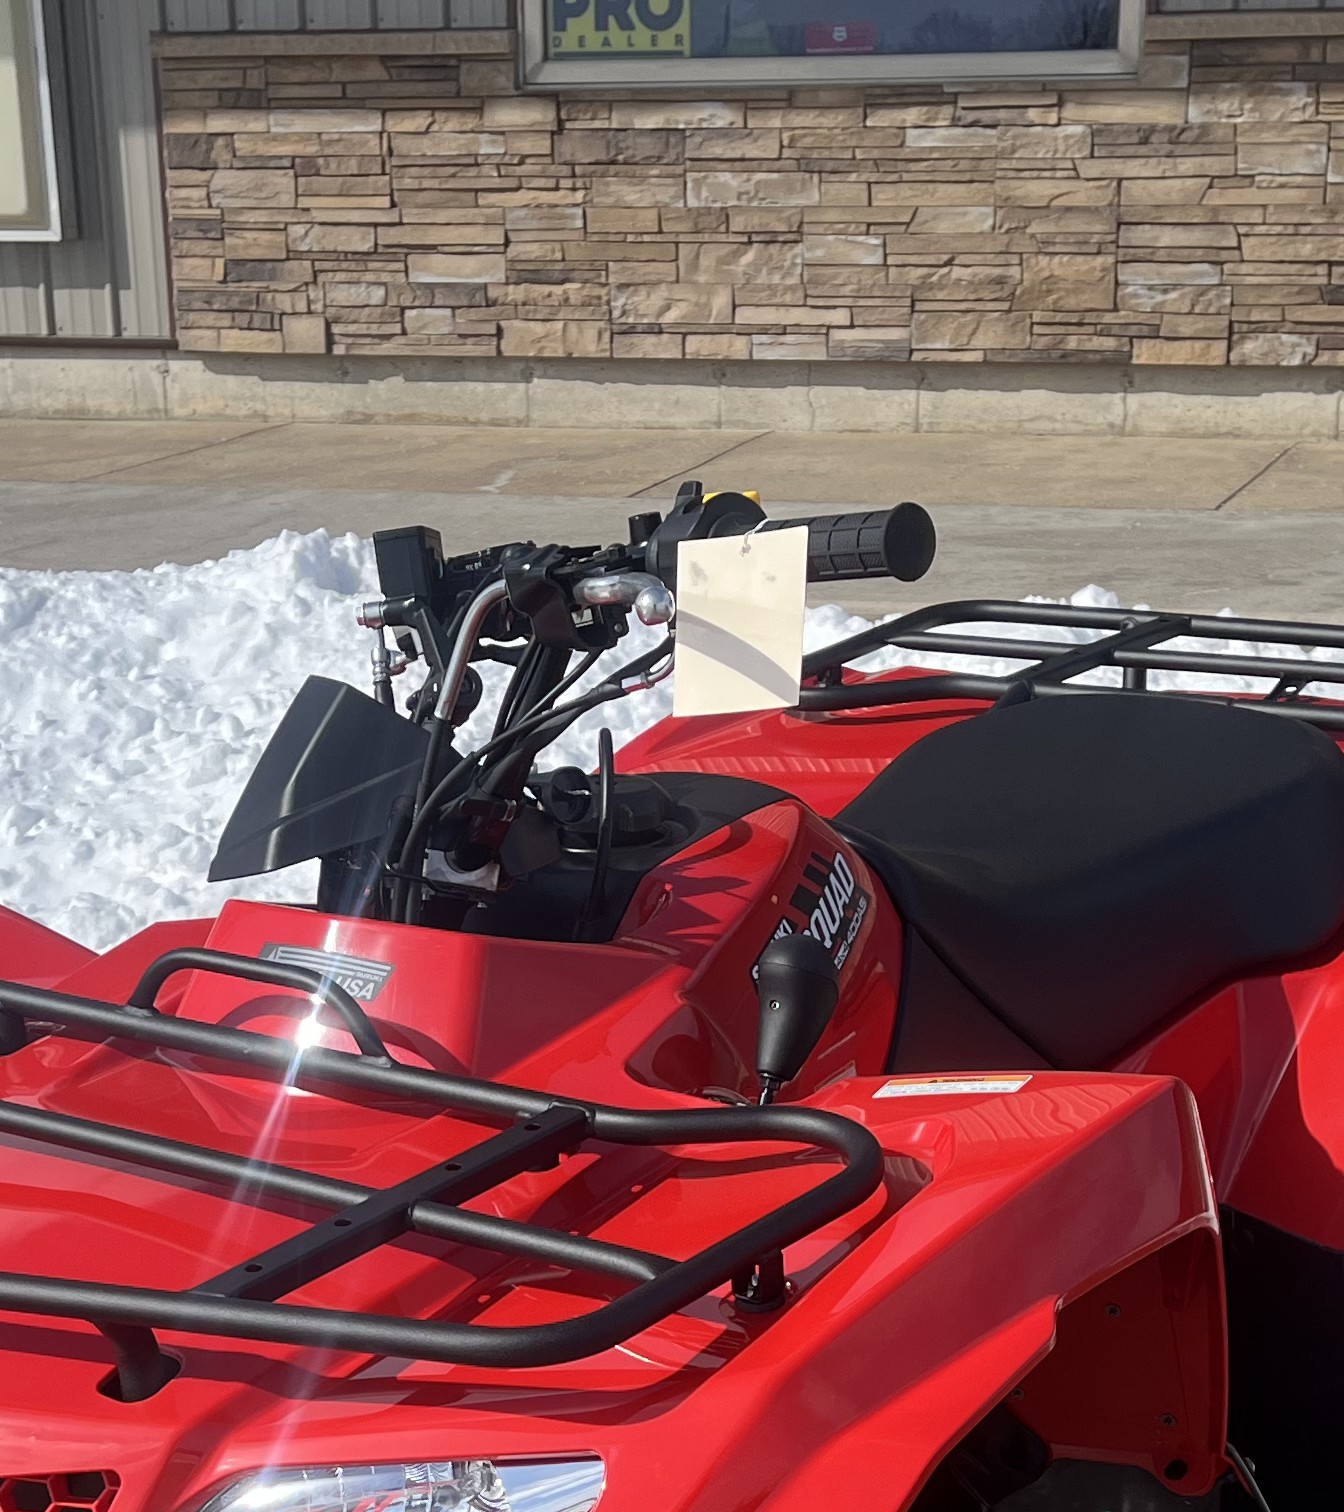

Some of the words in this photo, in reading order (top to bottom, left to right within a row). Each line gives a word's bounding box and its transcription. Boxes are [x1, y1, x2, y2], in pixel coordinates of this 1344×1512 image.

[552, 0, 684, 32] PRO
[552, 34, 684, 48] DEALER
[803, 852, 854, 949] QUAD
